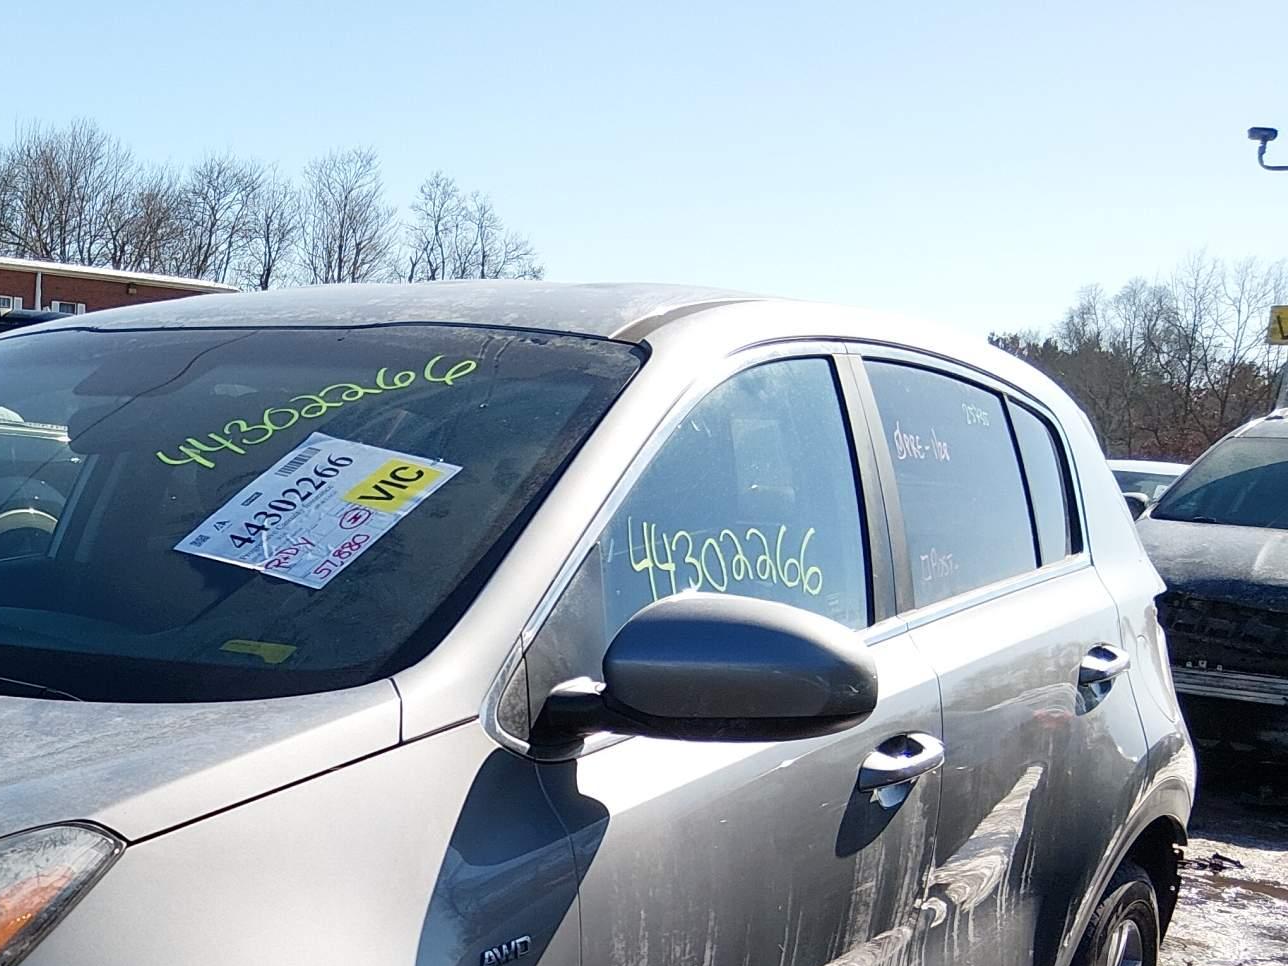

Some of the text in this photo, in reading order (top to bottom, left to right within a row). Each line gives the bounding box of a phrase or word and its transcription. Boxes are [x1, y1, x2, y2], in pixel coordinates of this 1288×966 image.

[157, 354, 477, 468] 44302266
[228, 454, 354, 550] 44302266
[357, 465, 425, 504] VIC
[627, 516, 824, 602] 44302266
